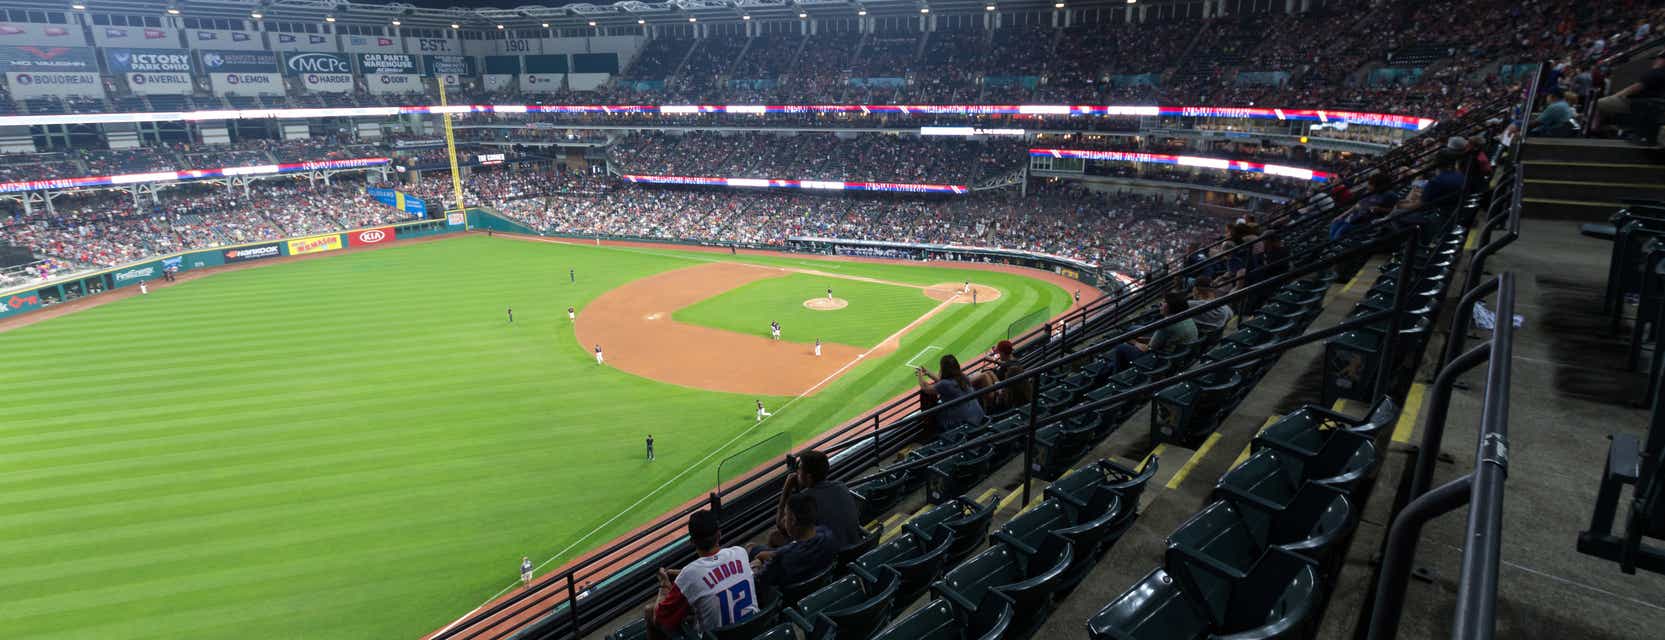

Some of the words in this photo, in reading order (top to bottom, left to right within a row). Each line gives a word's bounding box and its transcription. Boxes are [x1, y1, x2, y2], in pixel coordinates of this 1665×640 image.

[421, 40, 450, 52] EST.
[506, 40, 530, 52] 1901
[383, 54, 410, 62] PARTS
[299, 57, 350, 72] MCPc
[363, 60, 413, 68] WAREHOUSE
[34, 75, 94, 84] BOUDREAU
[147, 75, 189, 84] AVERILL
[240, 75, 270, 84] LEMON
[320, 75, 351, 84] HARDER
[363, 231, 381, 240] KIA
[702, 560, 744, 590] LINDOR
[716, 579, 753, 626] 12
